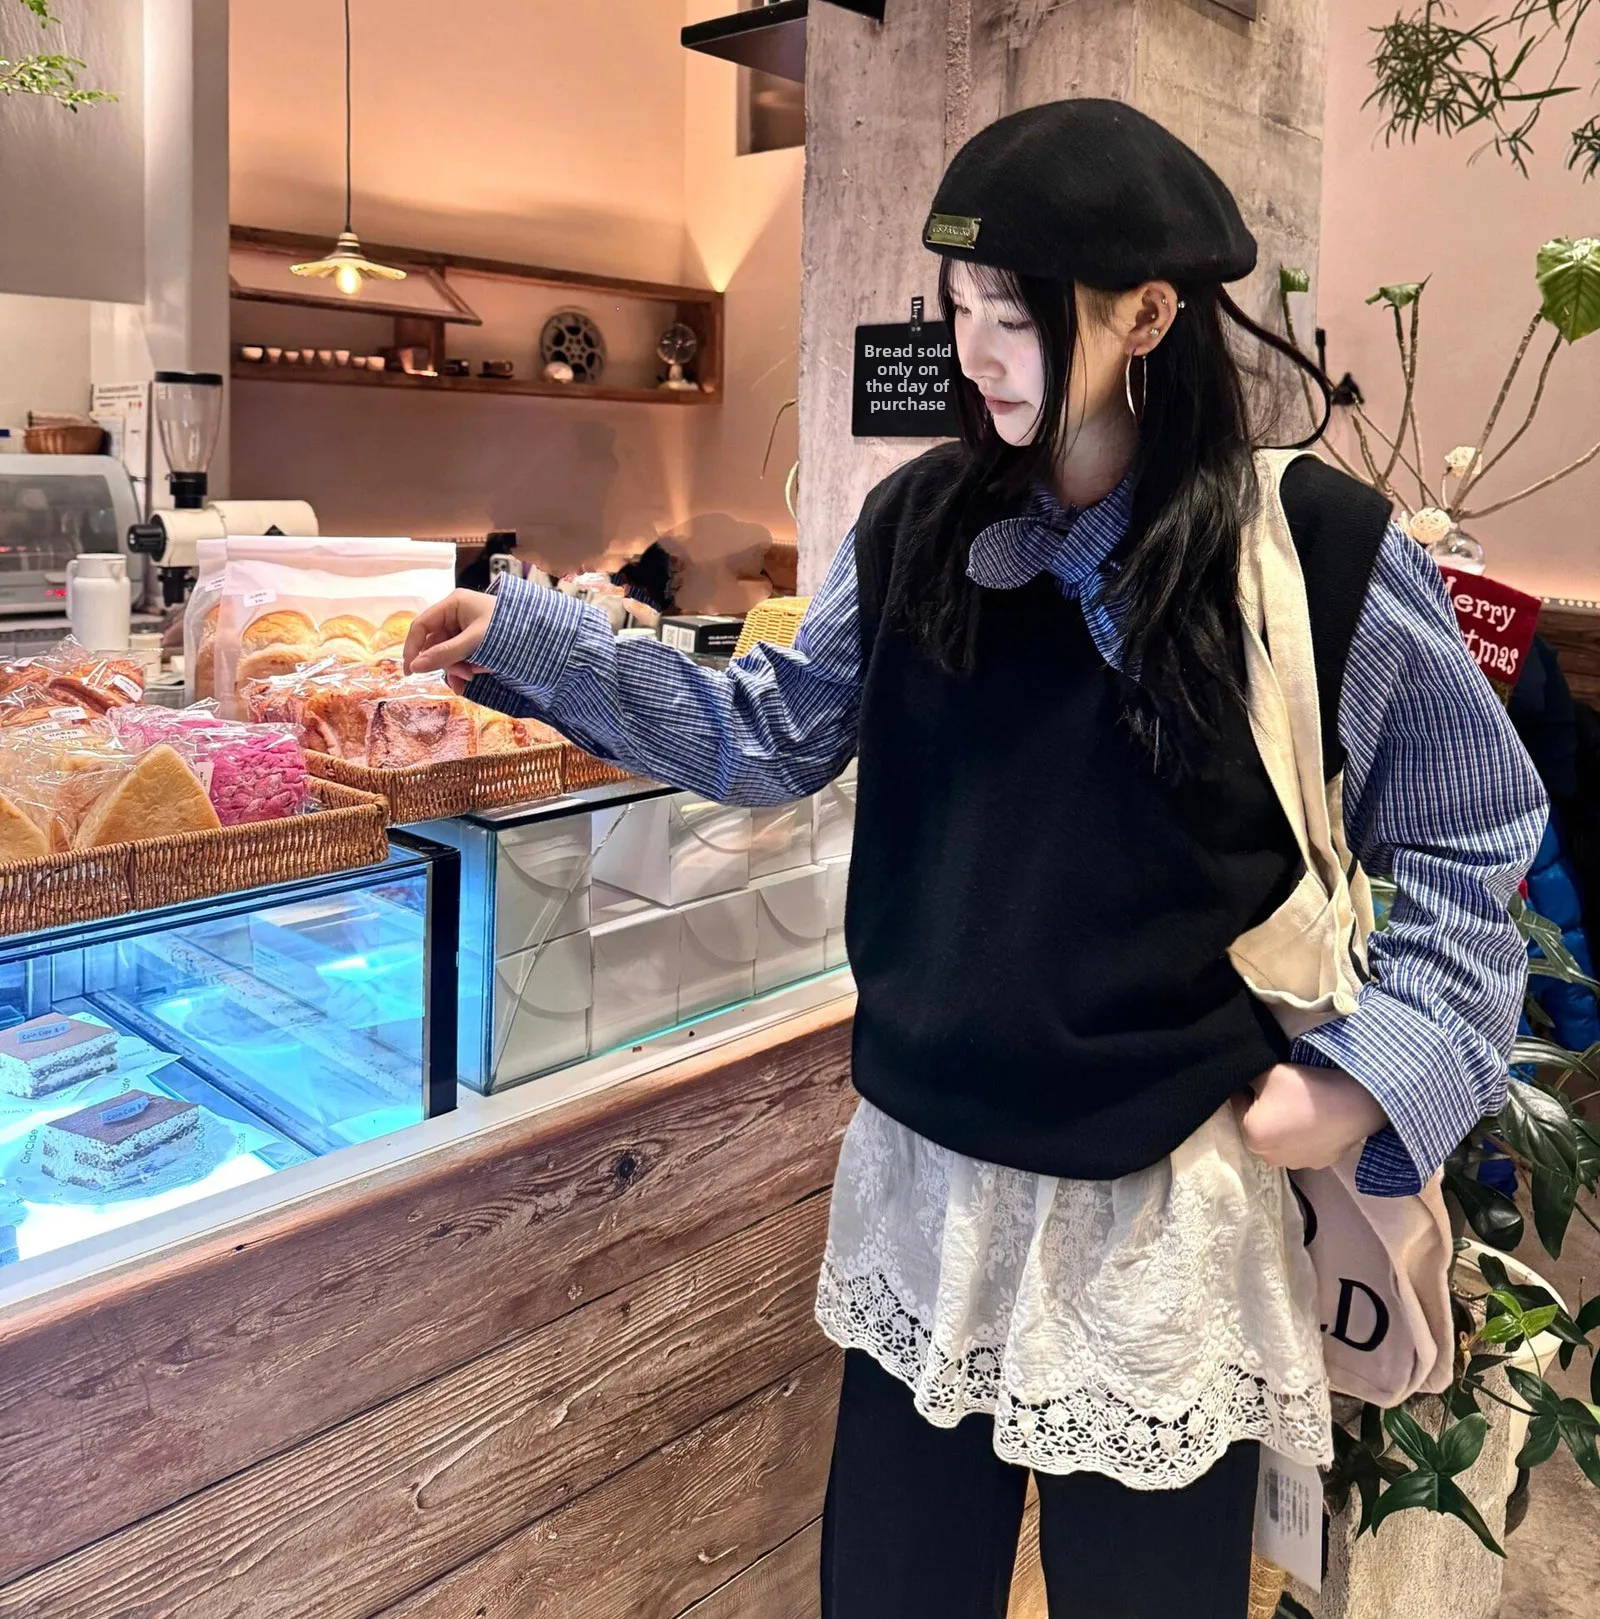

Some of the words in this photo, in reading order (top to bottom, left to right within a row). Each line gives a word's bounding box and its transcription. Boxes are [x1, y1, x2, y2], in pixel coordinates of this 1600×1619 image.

[865, 344, 913, 358] Bread
[918, 344, 952, 358] sold
[877, 362, 913, 378] only
[918, 365, 939, 376] on
[866, 379, 893, 393] the
[897, 379, 928, 395] day
[933, 379, 950, 393] of
[870, 397, 946, 413] purchase
[1462, 629, 1520, 675] tmas
